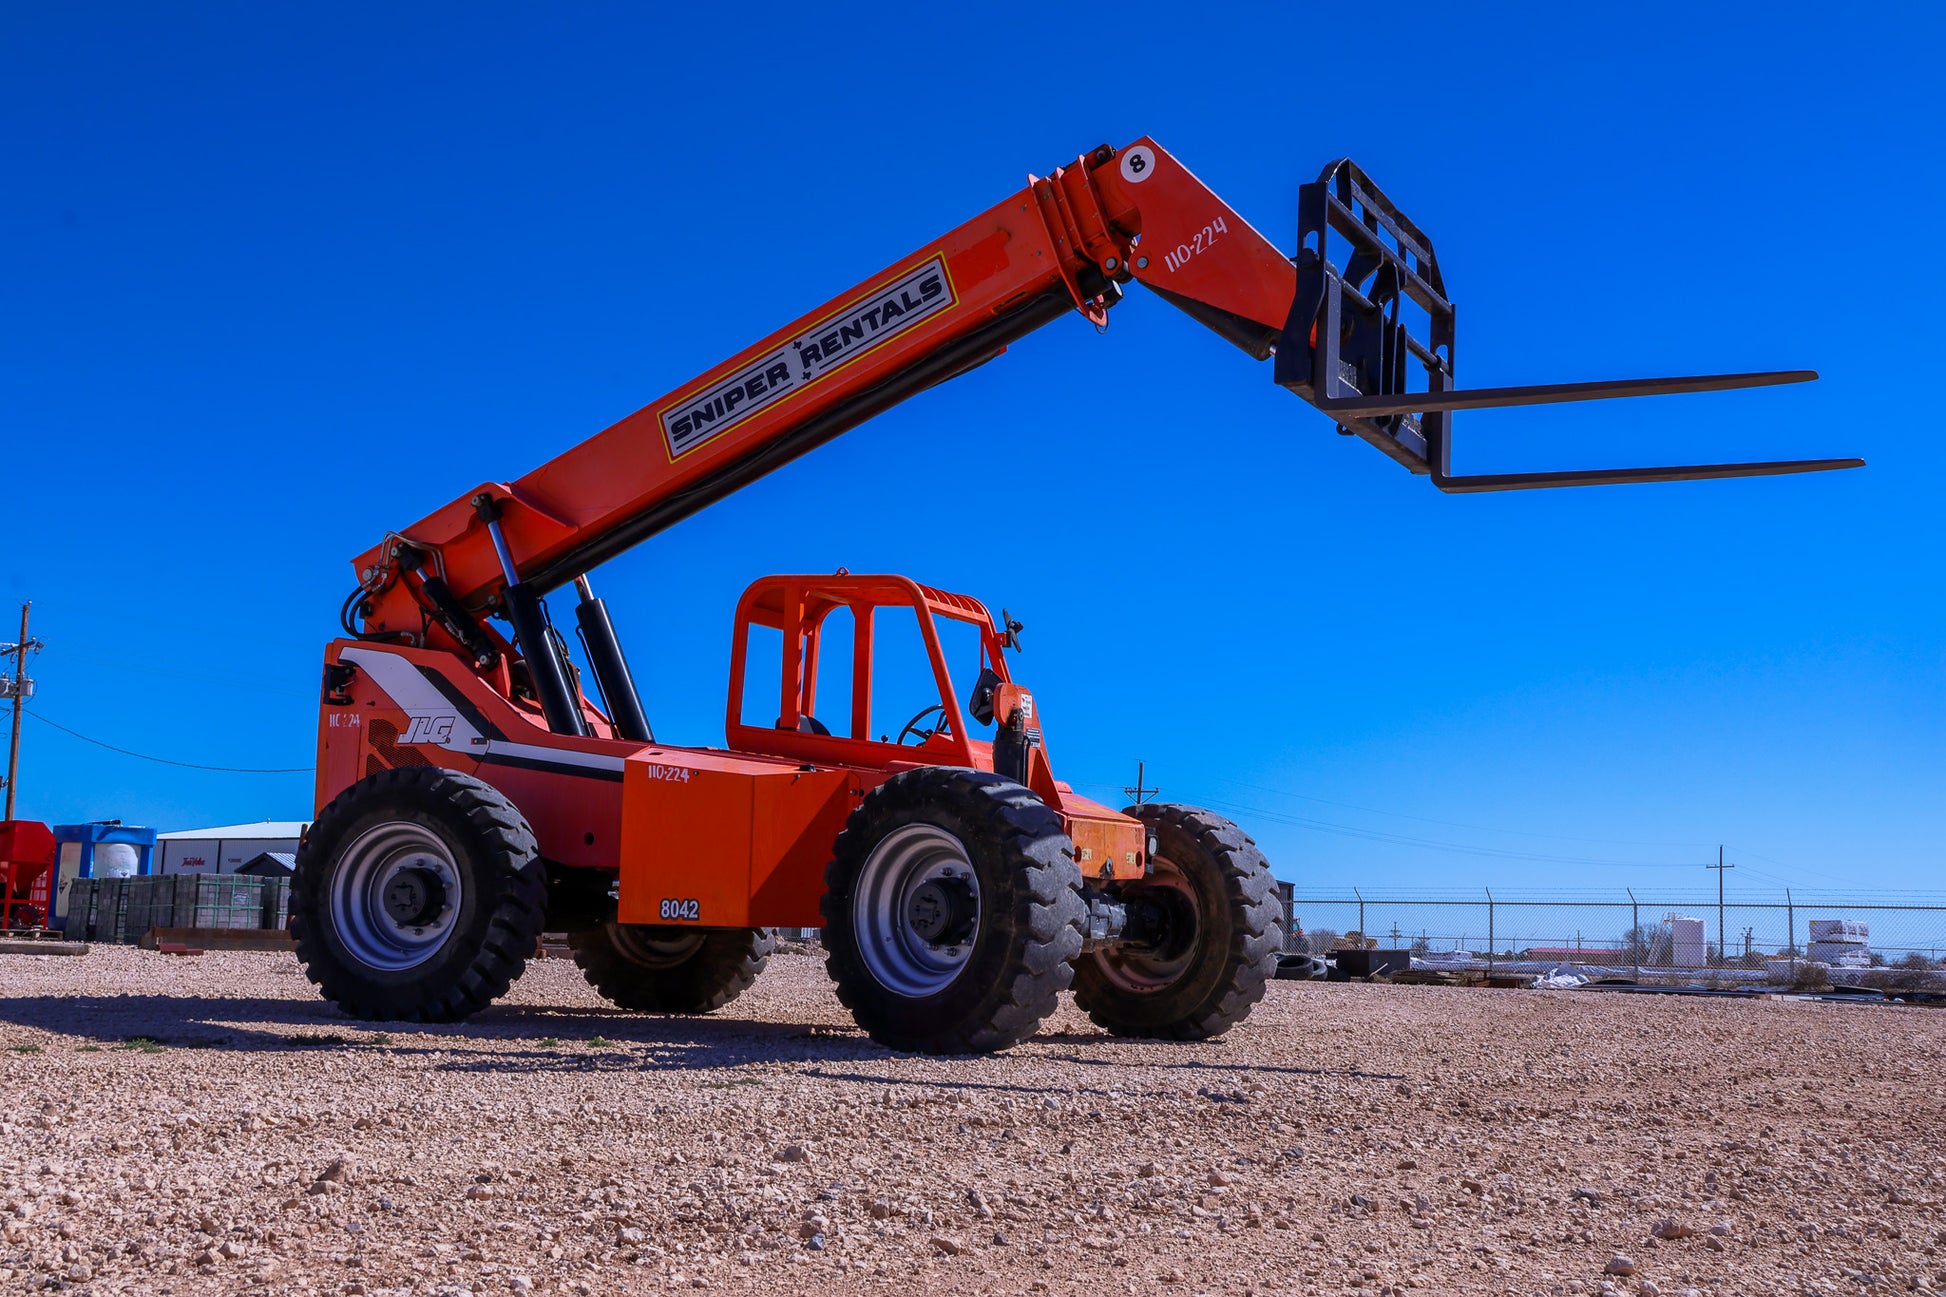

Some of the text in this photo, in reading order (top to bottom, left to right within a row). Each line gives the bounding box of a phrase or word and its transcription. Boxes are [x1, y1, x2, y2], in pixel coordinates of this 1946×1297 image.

[1128, 153, 1146, 174] 8
[1163, 215, 1229, 273] 110-224
[670, 273, 943, 443] SNIPER RENTALS
[397, 716, 456, 745] JLG
[648, 765, 690, 784] 110-224
[660, 899, 700, 920] 8042
